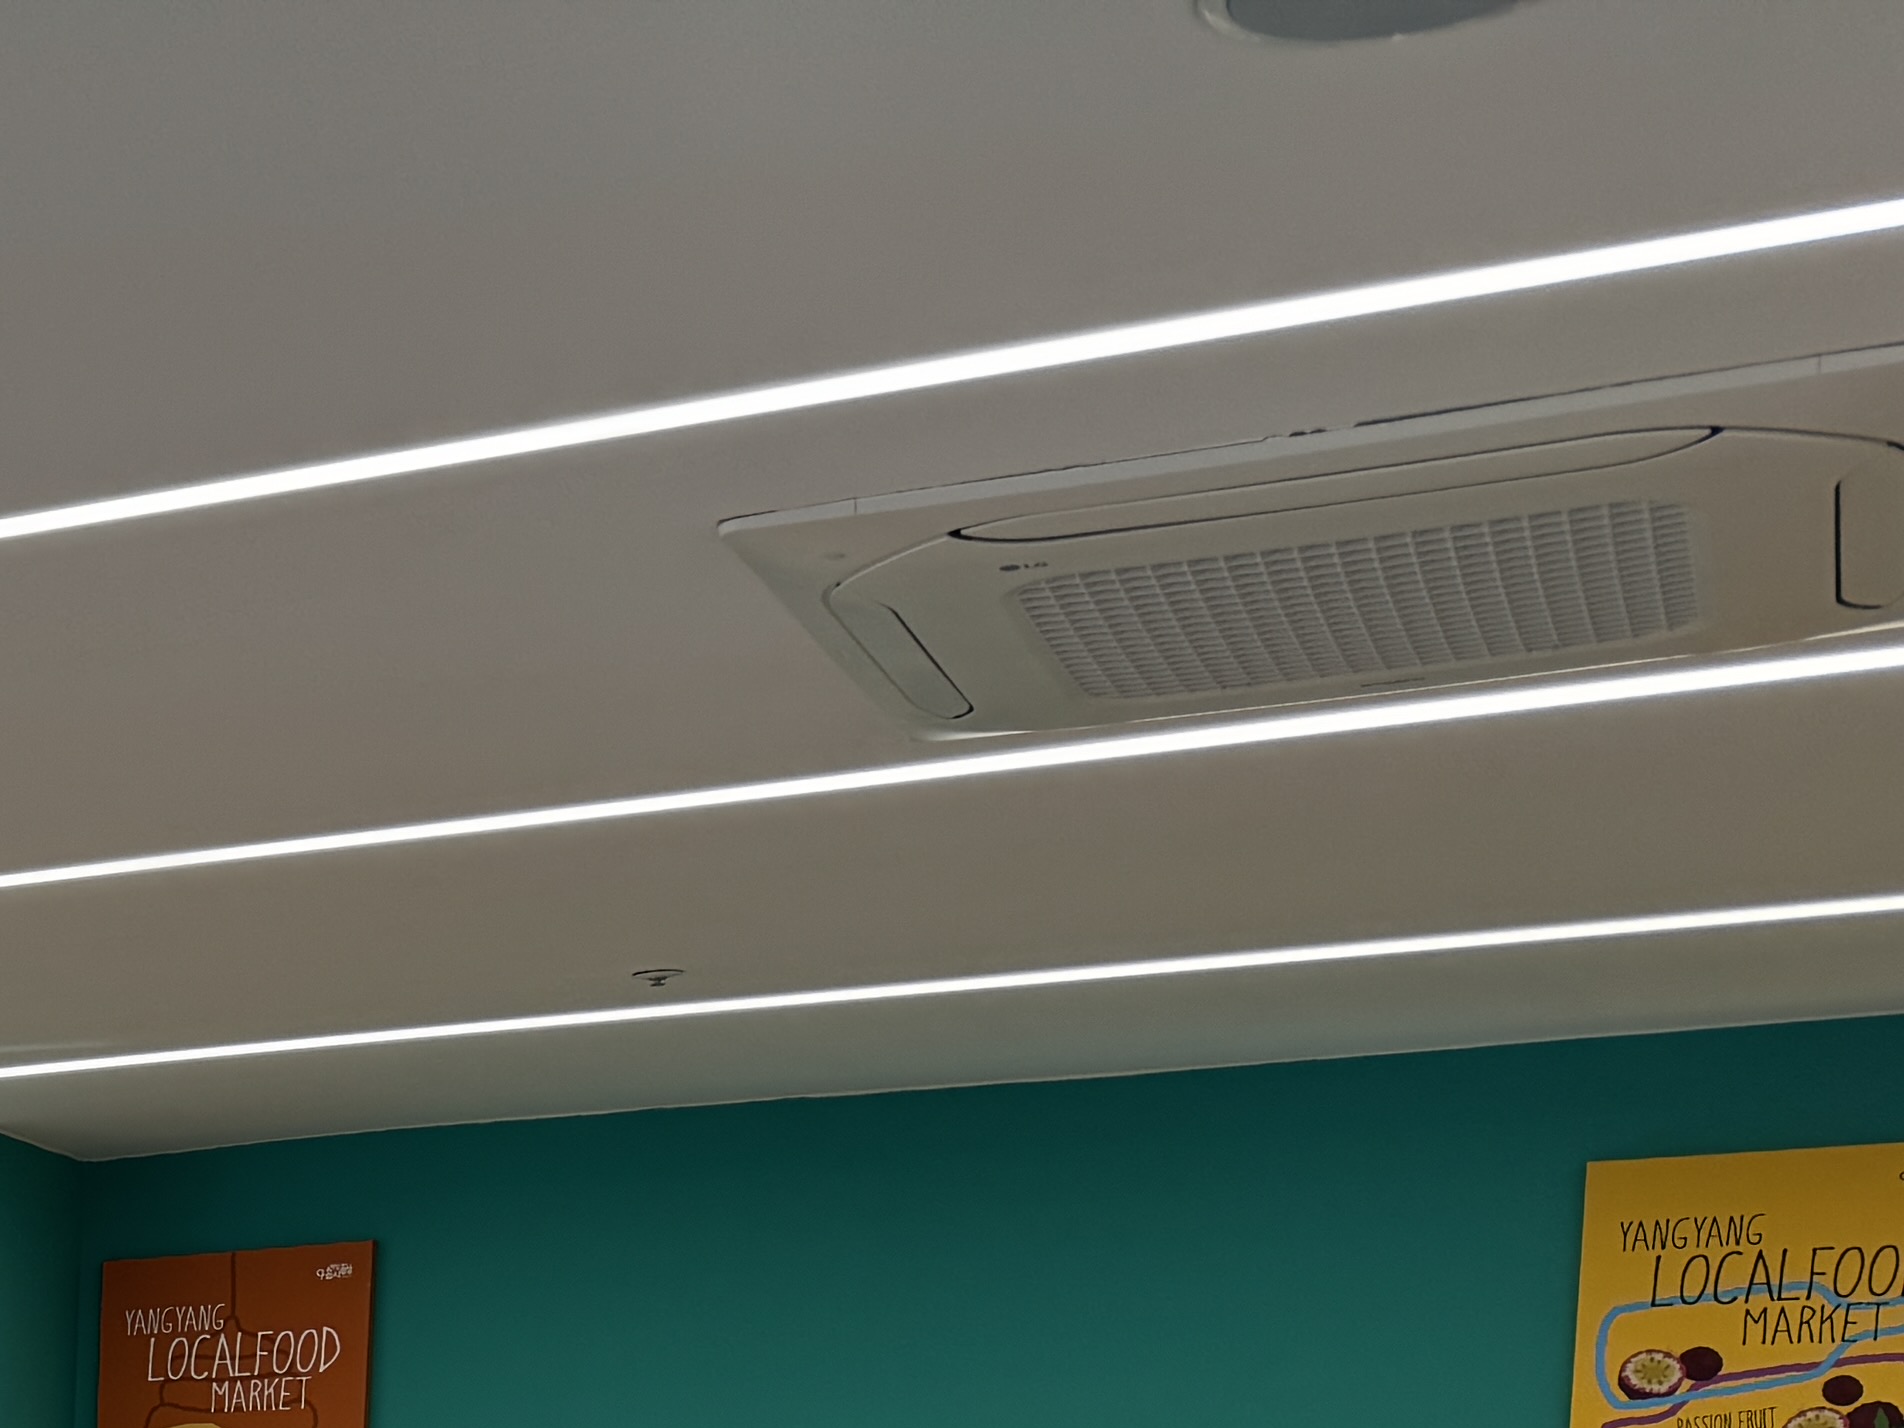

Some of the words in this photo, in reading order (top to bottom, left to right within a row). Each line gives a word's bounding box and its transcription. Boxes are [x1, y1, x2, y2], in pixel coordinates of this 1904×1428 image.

[1620, 1213, 1767, 1252] YANGYANG
[125, 1304, 225, 1336] YANGYANG
[1742, 1301, 1887, 1346] MARKET
[147, 1326, 341, 1381] LOCALFOOD
[211, 1375, 312, 1413] MARKET
